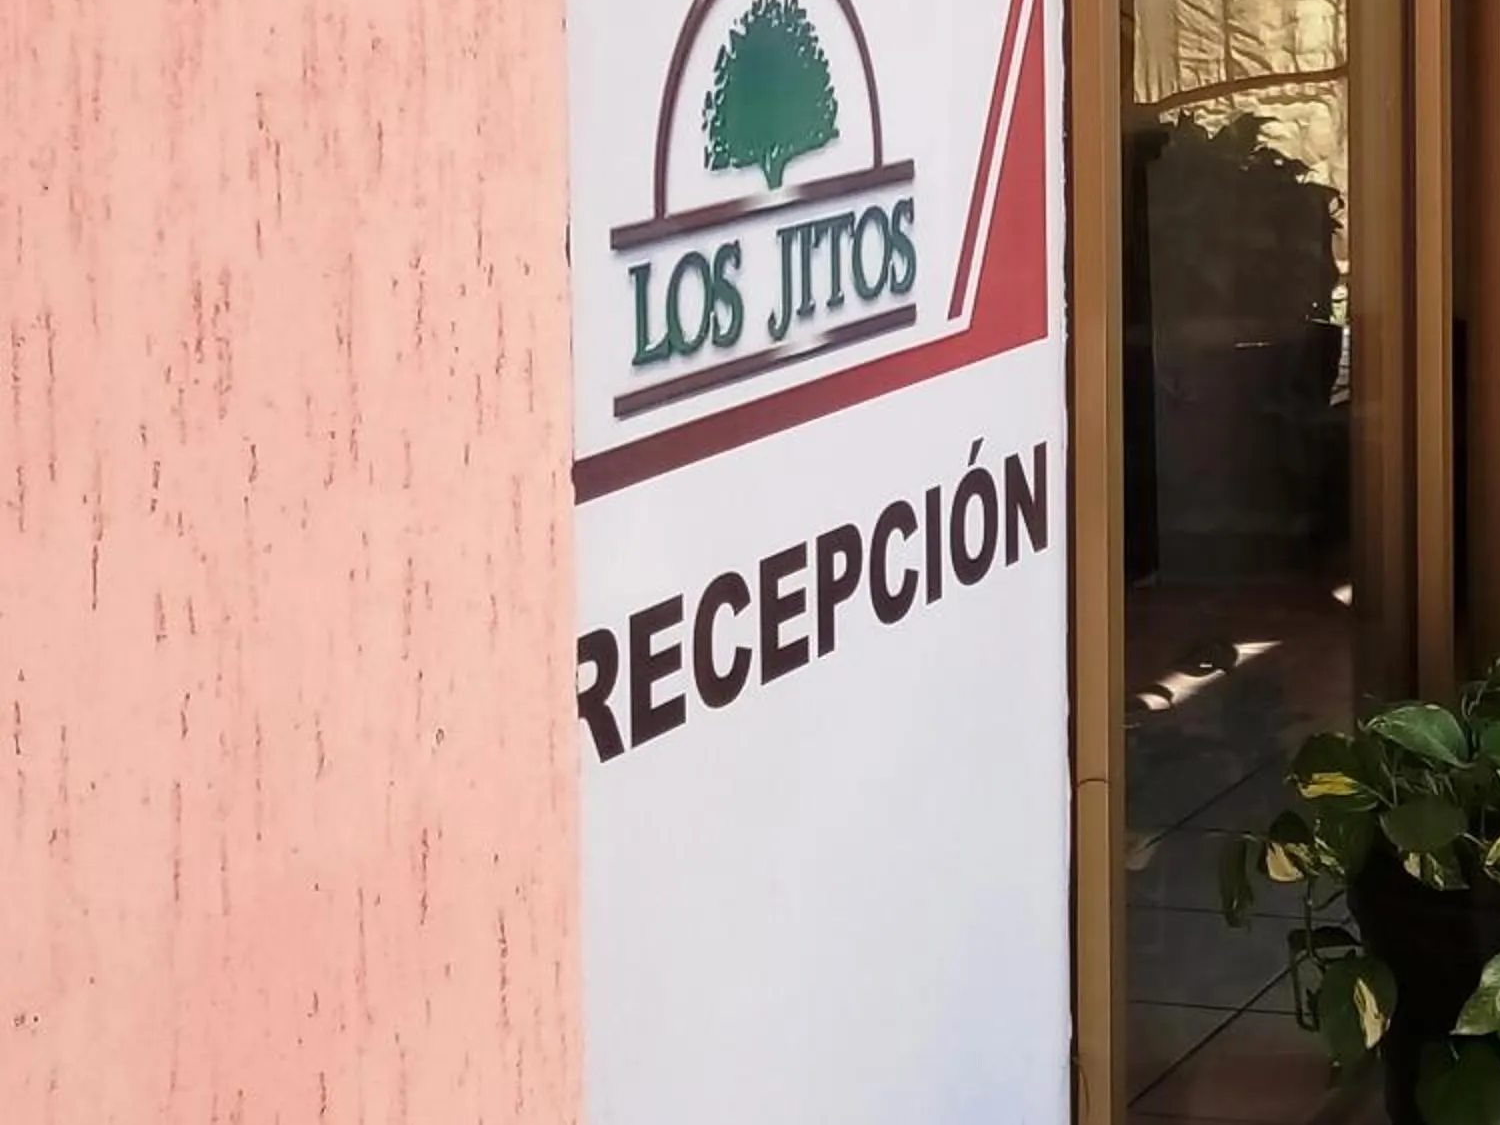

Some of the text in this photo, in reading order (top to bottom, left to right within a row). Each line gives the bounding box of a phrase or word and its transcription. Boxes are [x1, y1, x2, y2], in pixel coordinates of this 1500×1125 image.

[628, 197, 917, 367] LOS JITOS
[576, 437, 1049, 764] RECEPCIÓN
